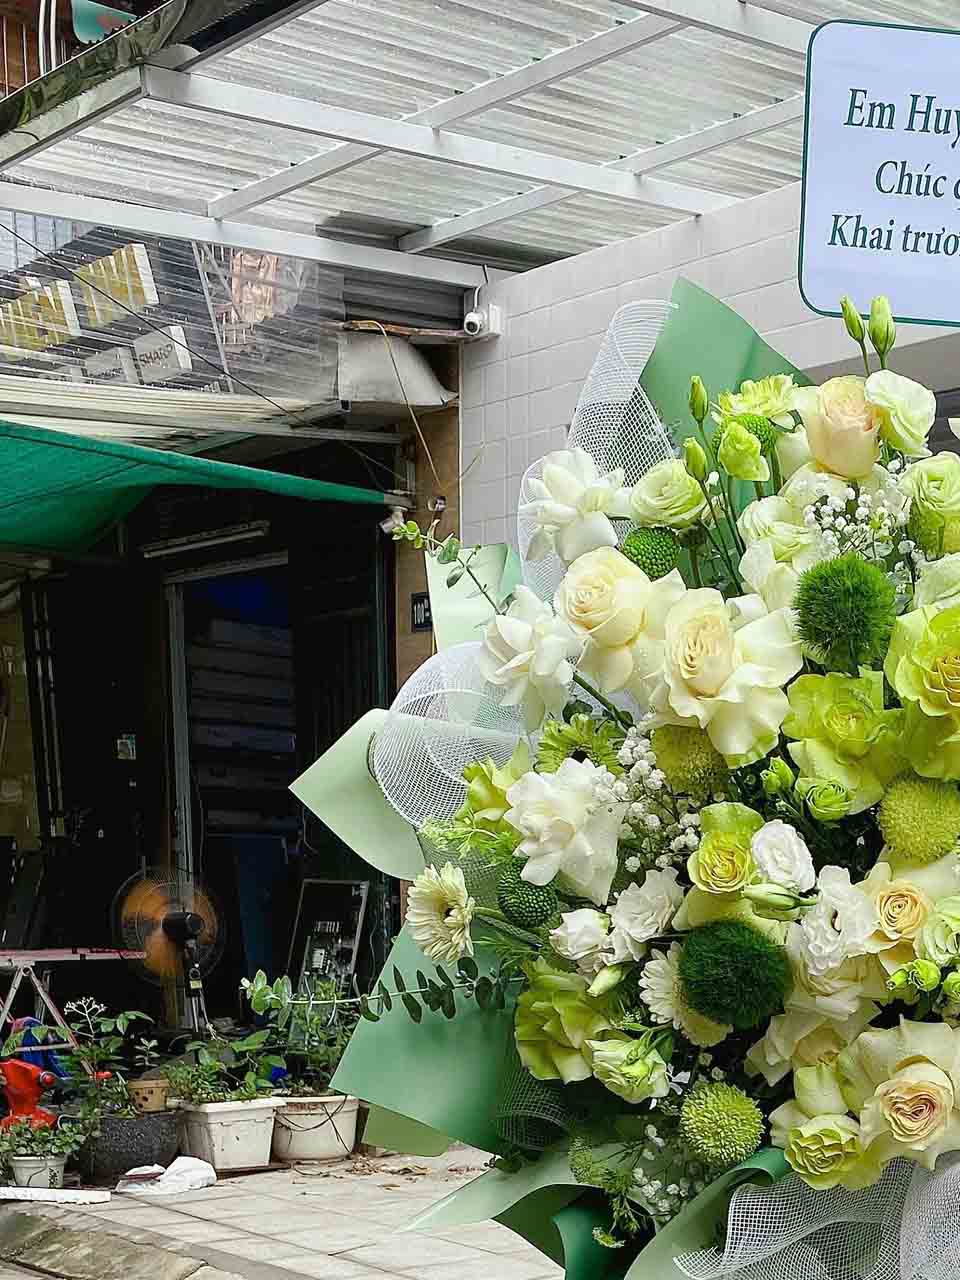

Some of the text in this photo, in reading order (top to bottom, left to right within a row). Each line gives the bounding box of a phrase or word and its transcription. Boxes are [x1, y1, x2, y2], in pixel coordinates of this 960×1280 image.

[843, 88, 896, 131] Em
[874, 159, 948, 199] Chúc
[827, 213, 894, 251] Khai
